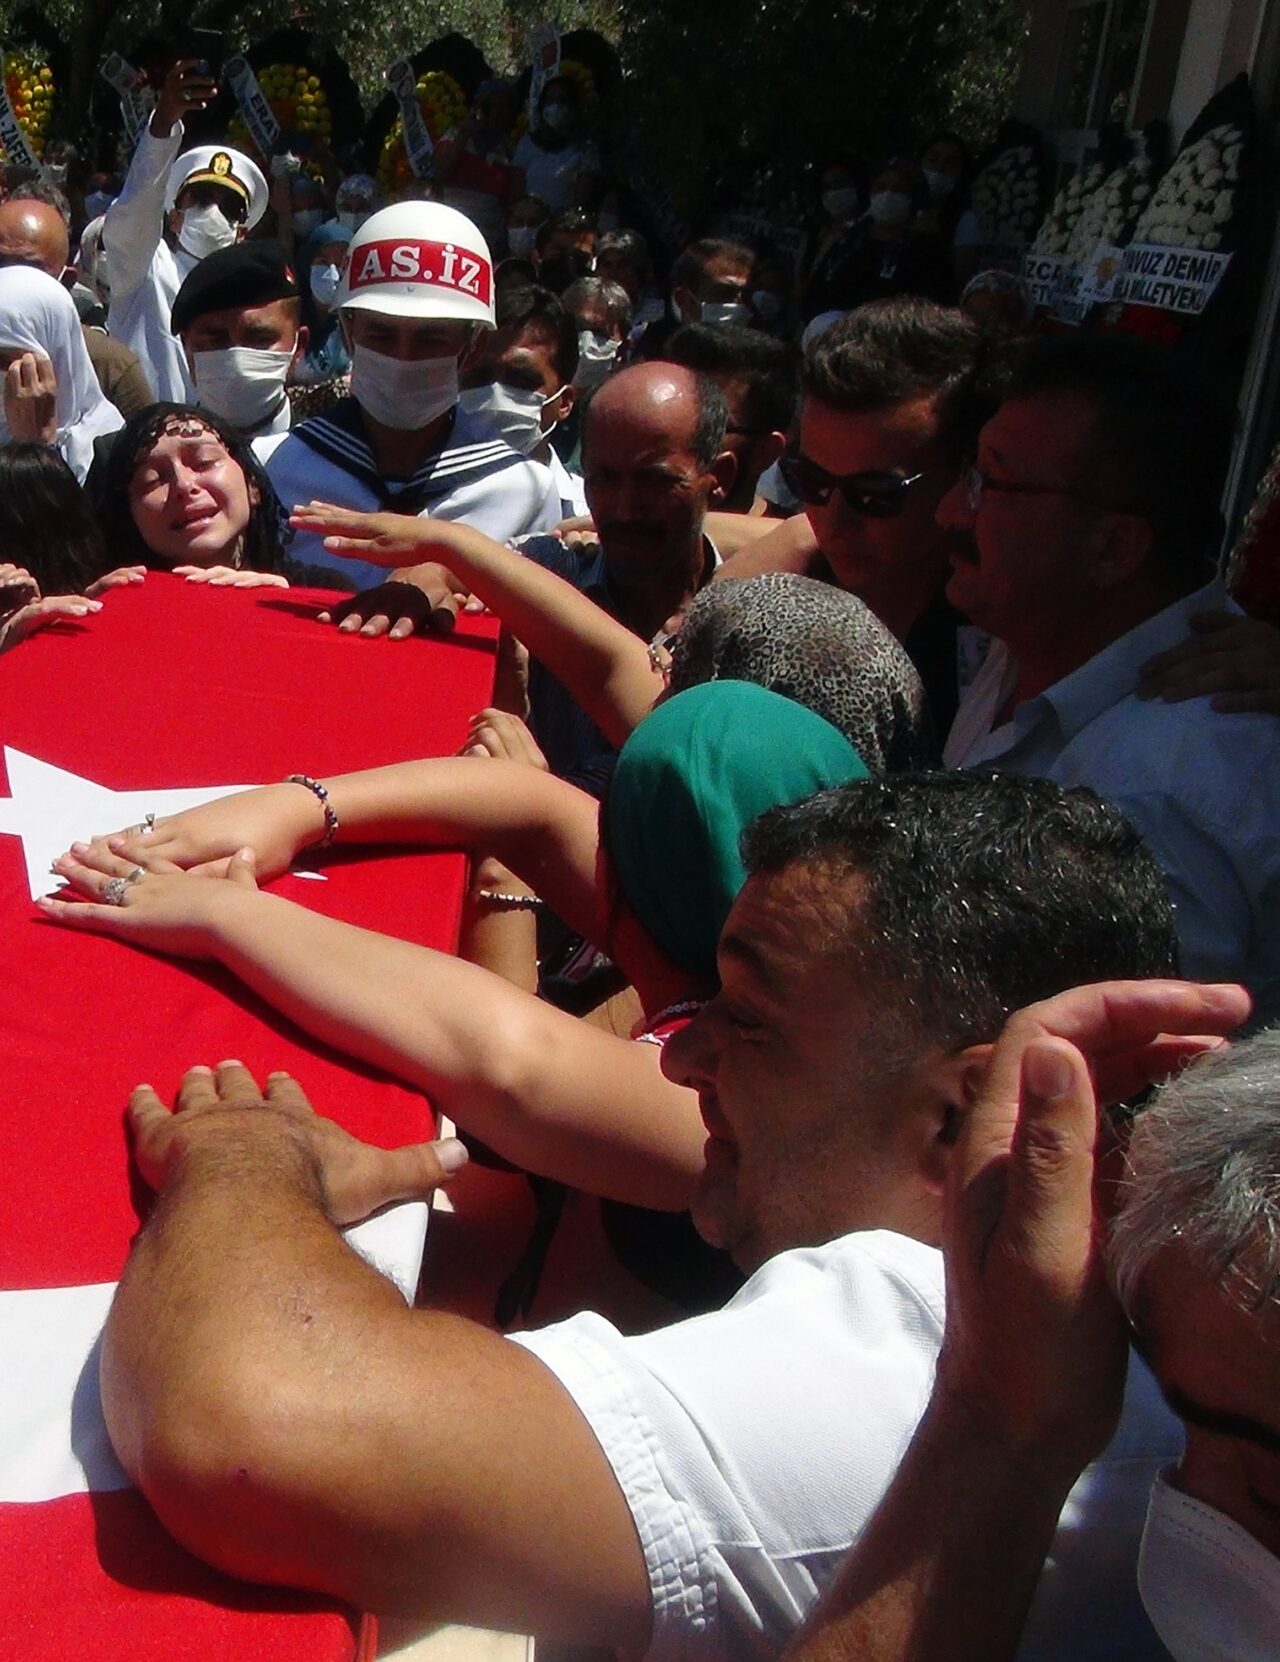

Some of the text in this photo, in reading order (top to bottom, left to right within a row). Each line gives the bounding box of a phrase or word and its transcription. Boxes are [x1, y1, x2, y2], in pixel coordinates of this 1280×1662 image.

[357, 244, 481, 295] AS.İZ
[1123, 250, 1222, 284] AVUZ DEMİR
